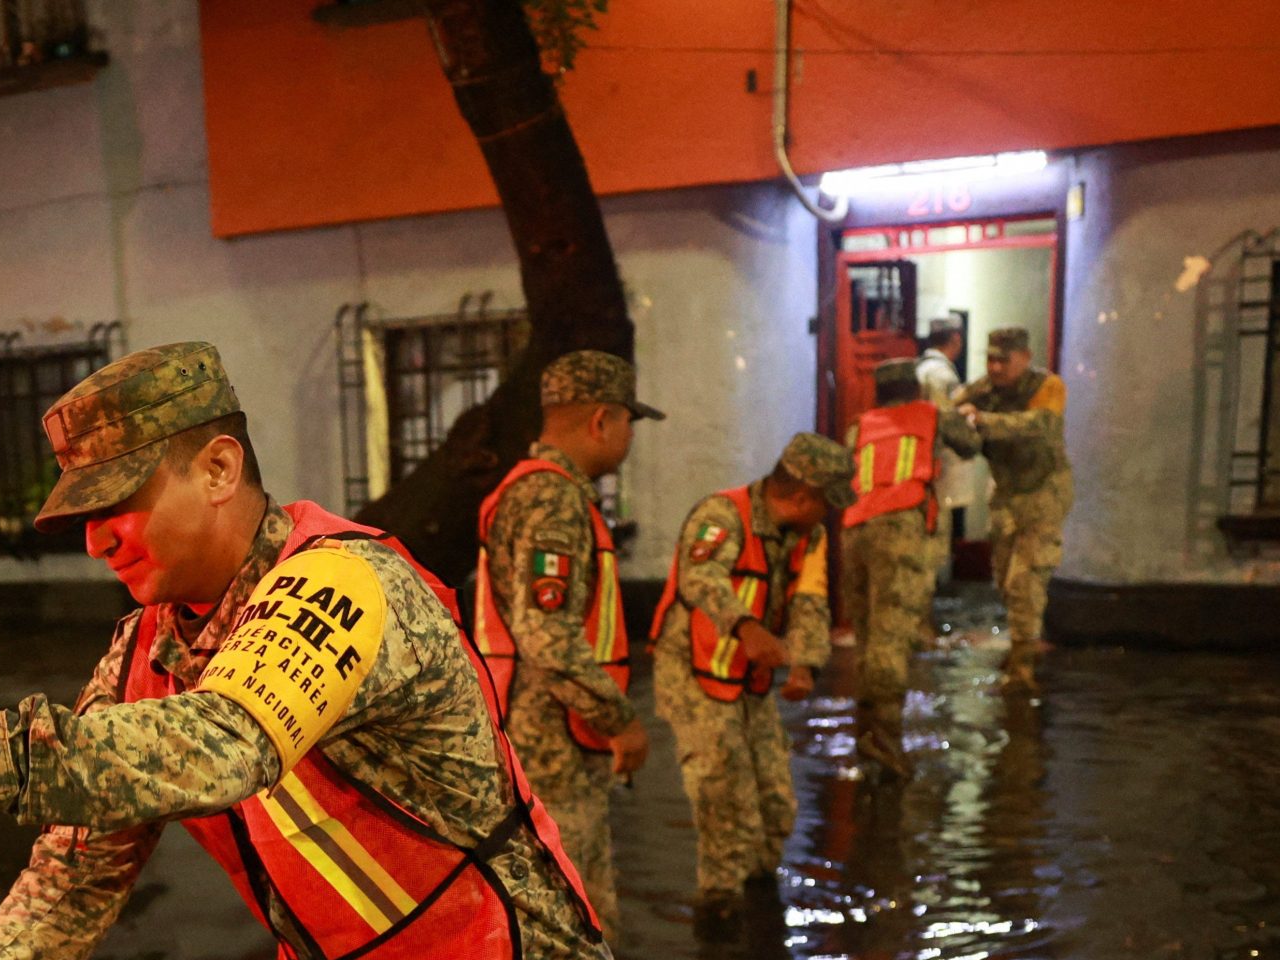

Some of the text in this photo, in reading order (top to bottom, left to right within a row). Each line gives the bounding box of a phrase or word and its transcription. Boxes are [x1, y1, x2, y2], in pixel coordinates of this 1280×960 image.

[266, 576, 364, 632] PLAN
[220, 640, 268, 658] ERZA
[252, 660, 267, 674] Y
[242, 675, 306, 749] NACIONAL
